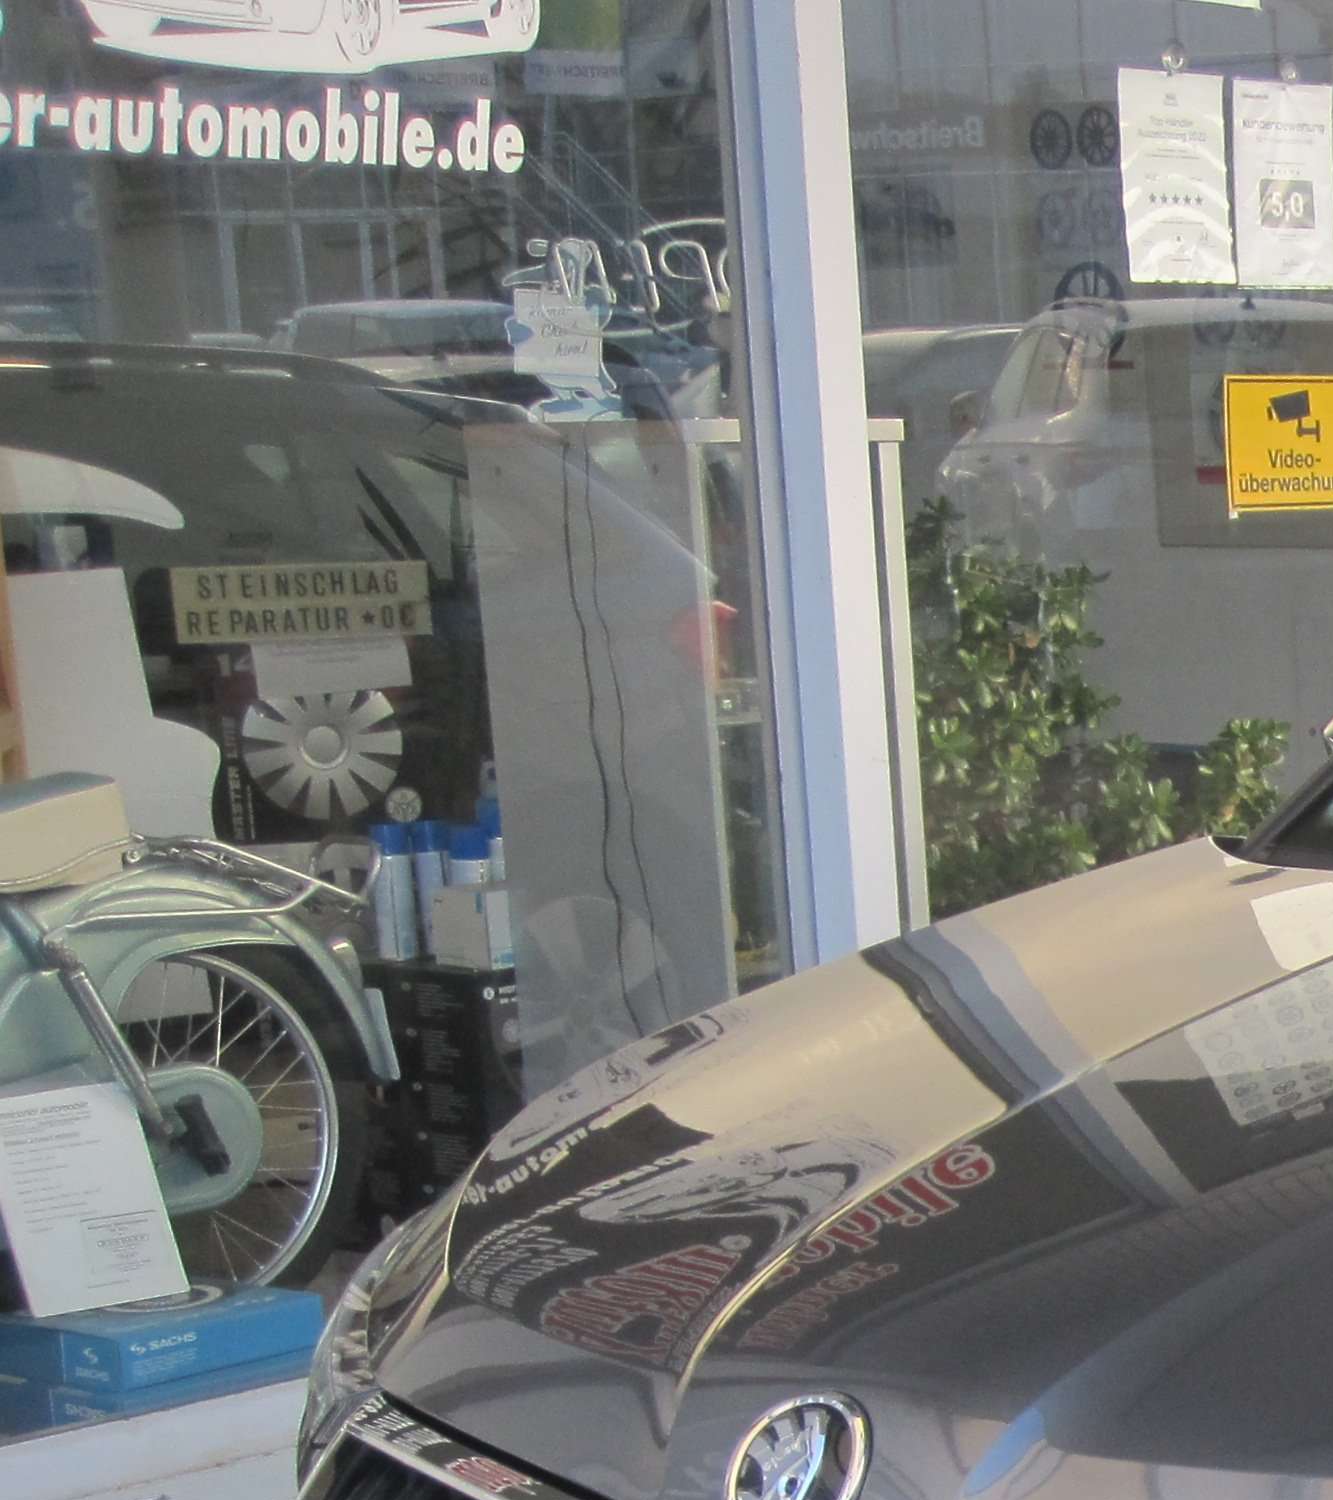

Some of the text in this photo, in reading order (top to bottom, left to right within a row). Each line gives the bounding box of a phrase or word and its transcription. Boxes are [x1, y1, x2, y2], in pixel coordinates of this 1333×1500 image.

[1267, 448, 1322, 469] Video-
[196, 569, 399, 600] STEINSCHLAG
[186, 606, 350, 636] REPARATUR
[149, 1331, 198, 1351] SACHS
